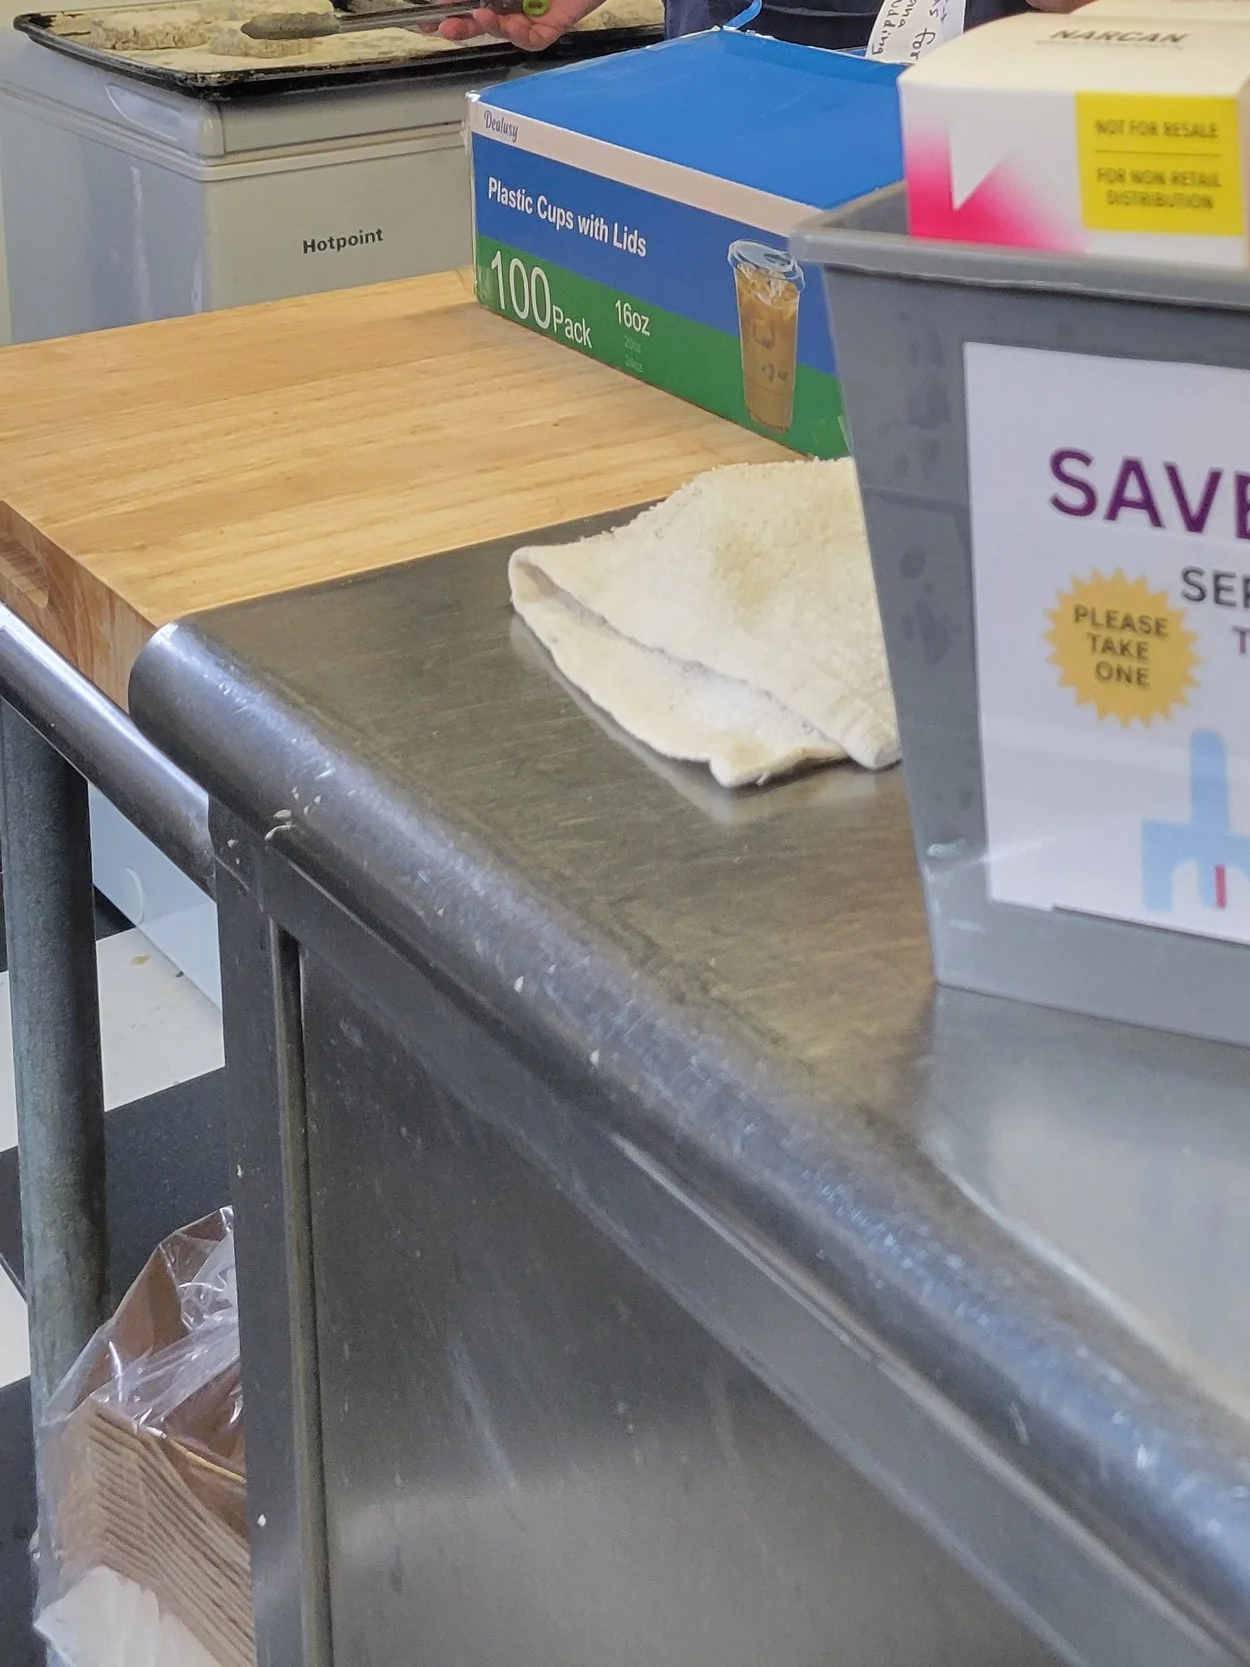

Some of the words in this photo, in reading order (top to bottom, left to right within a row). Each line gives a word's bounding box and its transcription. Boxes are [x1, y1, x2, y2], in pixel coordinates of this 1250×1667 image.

[1049, 28, 1188, 45] NARCAN
[484, 110, 519, 143] Dealusy
[1094, 118, 1125, 136] NOT
[1129, 120, 1159, 137] FOR
[1163, 120, 1218, 139] RESALE
[1097, 167, 1126, 185] FOR
[1106, 189, 1215, 210] DISTRIBUTION
[488, 176, 533, 214] Plastic
[537, 194, 574, 231] Cups
[578, 213, 608, 244] with
[612, 222, 647, 257] Lids
[303, 228, 384, 253] Hotpoint
[491, 250, 551, 330] 100
[552, 304, 592, 348] Pack
[615, 299, 651, 336] 16oz
[1074, 604, 1168, 638] PLEASE
[1086, 632, 1150, 661] TAKE
[1096, 661, 1150, 688] ONE
